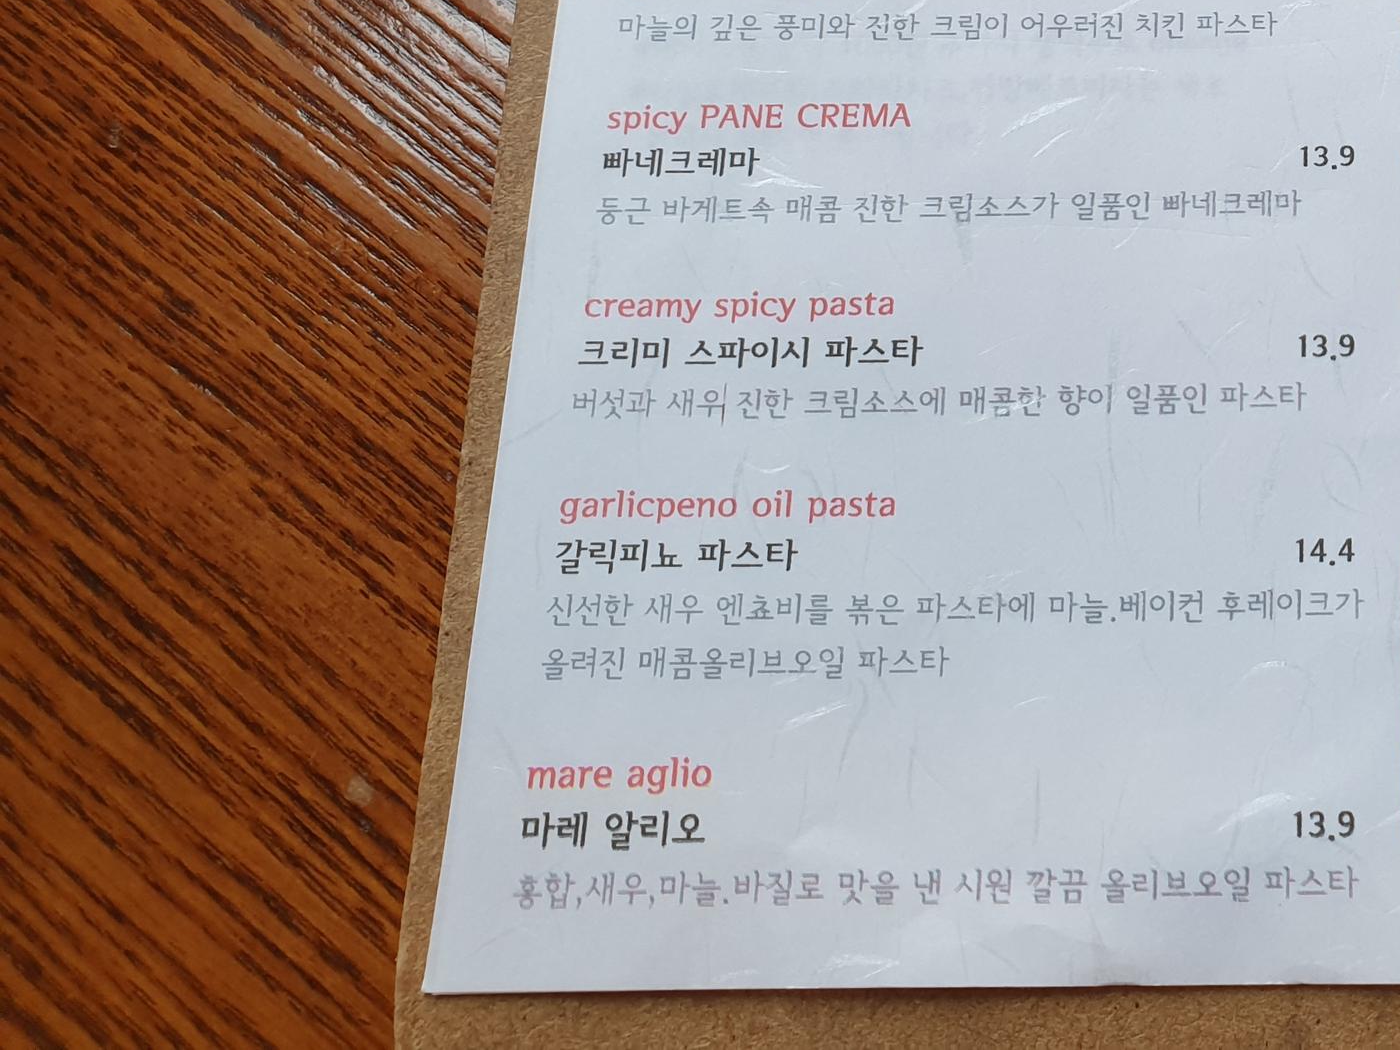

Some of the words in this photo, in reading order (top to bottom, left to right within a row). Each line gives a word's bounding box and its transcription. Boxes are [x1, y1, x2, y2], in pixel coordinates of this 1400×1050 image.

[618, 13, 698, 43] 마늘의
[710, 13, 763, 42] 깊은
[773, 12, 856, 41] 풍미와
[865, 12, 921, 41] 진한
[930, 12, 1008, 41] 크림이
[1020, 12, 1123, 40] 어우러진
[1135, 11, 1184, 40] 치킨
[1196, 10, 1279, 38] 파스타
[606, 104, 688, 136] spicy
[700, 103, 784, 129] PANE
[797, 102, 912, 129] CREMA
[602, 147, 761, 178] 빠네크레마
[1300, 144, 1355, 171] 13.9
[595, 197, 652, 226] 둥근
[662, 195, 776, 224] 바게트속
[785, 194, 843, 224] 매콤
[853, 193, 910, 224] 진한
[919, 191, 1060, 225] 크림소스가
[1070, 190, 1150, 222] 일품인
[1161, 189, 1303, 219] 빠네크레마
[584, 298, 702, 324] creamy
[713, 290, 797, 324] spicy
[808, 291, 895, 323] pasta
[577, 337, 670, 370] 크리미
[684, 336, 810, 370] 스파이시
[824, 334, 925, 368] 파스타
[1298, 333, 1355, 362] 13.9
[559, 489, 738, 525] garlicpeno
[752, 489, 793, 518] oil
[807, 491, 896, 525] pasta
[555, 538, 684, 575] 갈릭피뇨
[697, 538, 799, 573] 파스타
[1295, 537, 1356, 567] 14.4
[546, 593, 635, 627] 신선한
[644, 592, 704, 625] 새우
[716, 592, 834, 626] 엔쵸비를
[844, 593, 905, 626] 볶은
[916, 591, 1035, 624] 파스타에
[1216, 587, 1365, 622] 후레이크가
[541, 646, 626, 681] 올려진
[638, 645, 845, 681] 매콤올리브오일
[857, 645, 951, 678] 파스타
[527, 765, 613, 790] mare
[626, 756, 712, 795] aglio
[521, 811, 589, 851] 마레
[605, 810, 706, 851] 알리오
[1293, 810, 1355, 843] 13.9
[837, 868, 900, 906] 맛을
[913, 868, 942, 906] 낸
[955, 867, 1012, 905] 시원
[1026, 867, 1089, 905] 깔끔
[1100, 865, 1251, 904] 올리브오일
[1263, 864, 1360, 900] 파스타
